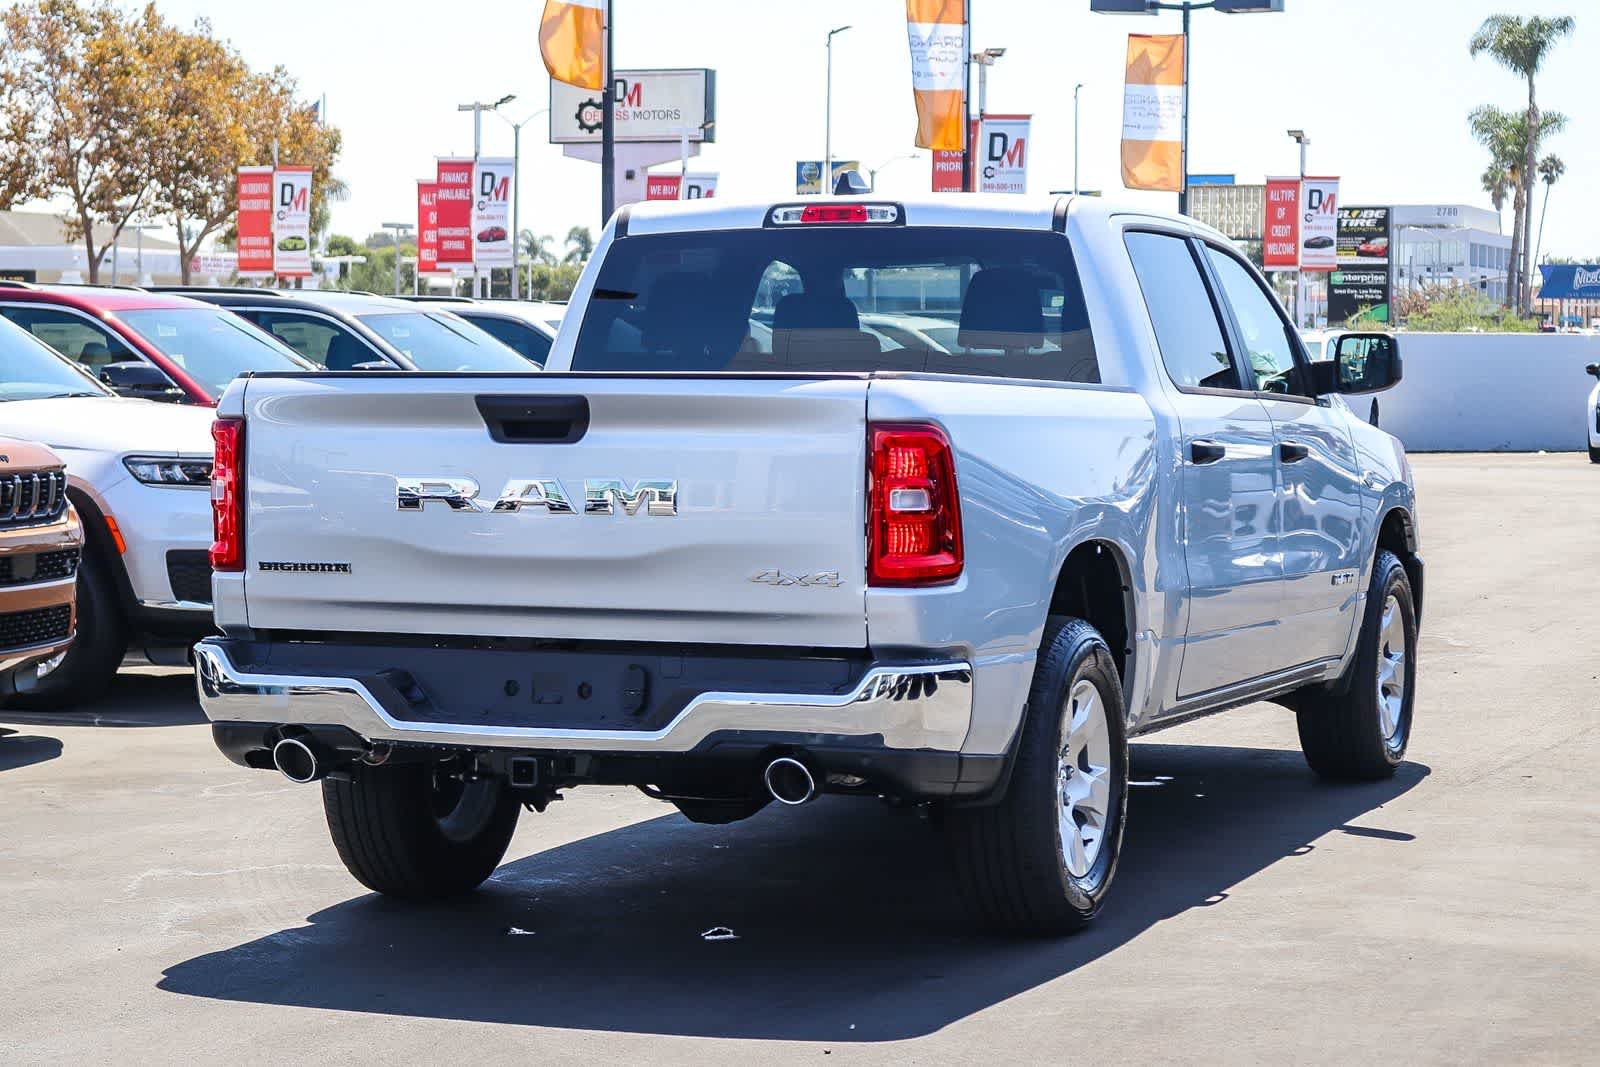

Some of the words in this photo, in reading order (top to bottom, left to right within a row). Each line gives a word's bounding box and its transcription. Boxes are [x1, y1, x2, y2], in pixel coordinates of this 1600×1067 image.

[584, 111, 630, 121] DESS
[633, 109, 681, 120] MOTORS
[989, 132, 1025, 168] DM
[281, 181, 308, 212] DM
[481, 171, 509, 202] DM
[650, 184, 662, 196] WE
[663, 183, 679, 196] BUY
[1308, 188, 1336, 216] DM
[1340, 219, 1378, 227] TIRE
[1267, 242, 1296, 256] WELCOME
[396, 475, 679, 516] RAM
[258, 561, 352, 574] BIGHORN
[749, 568, 845, 588] 4x4
